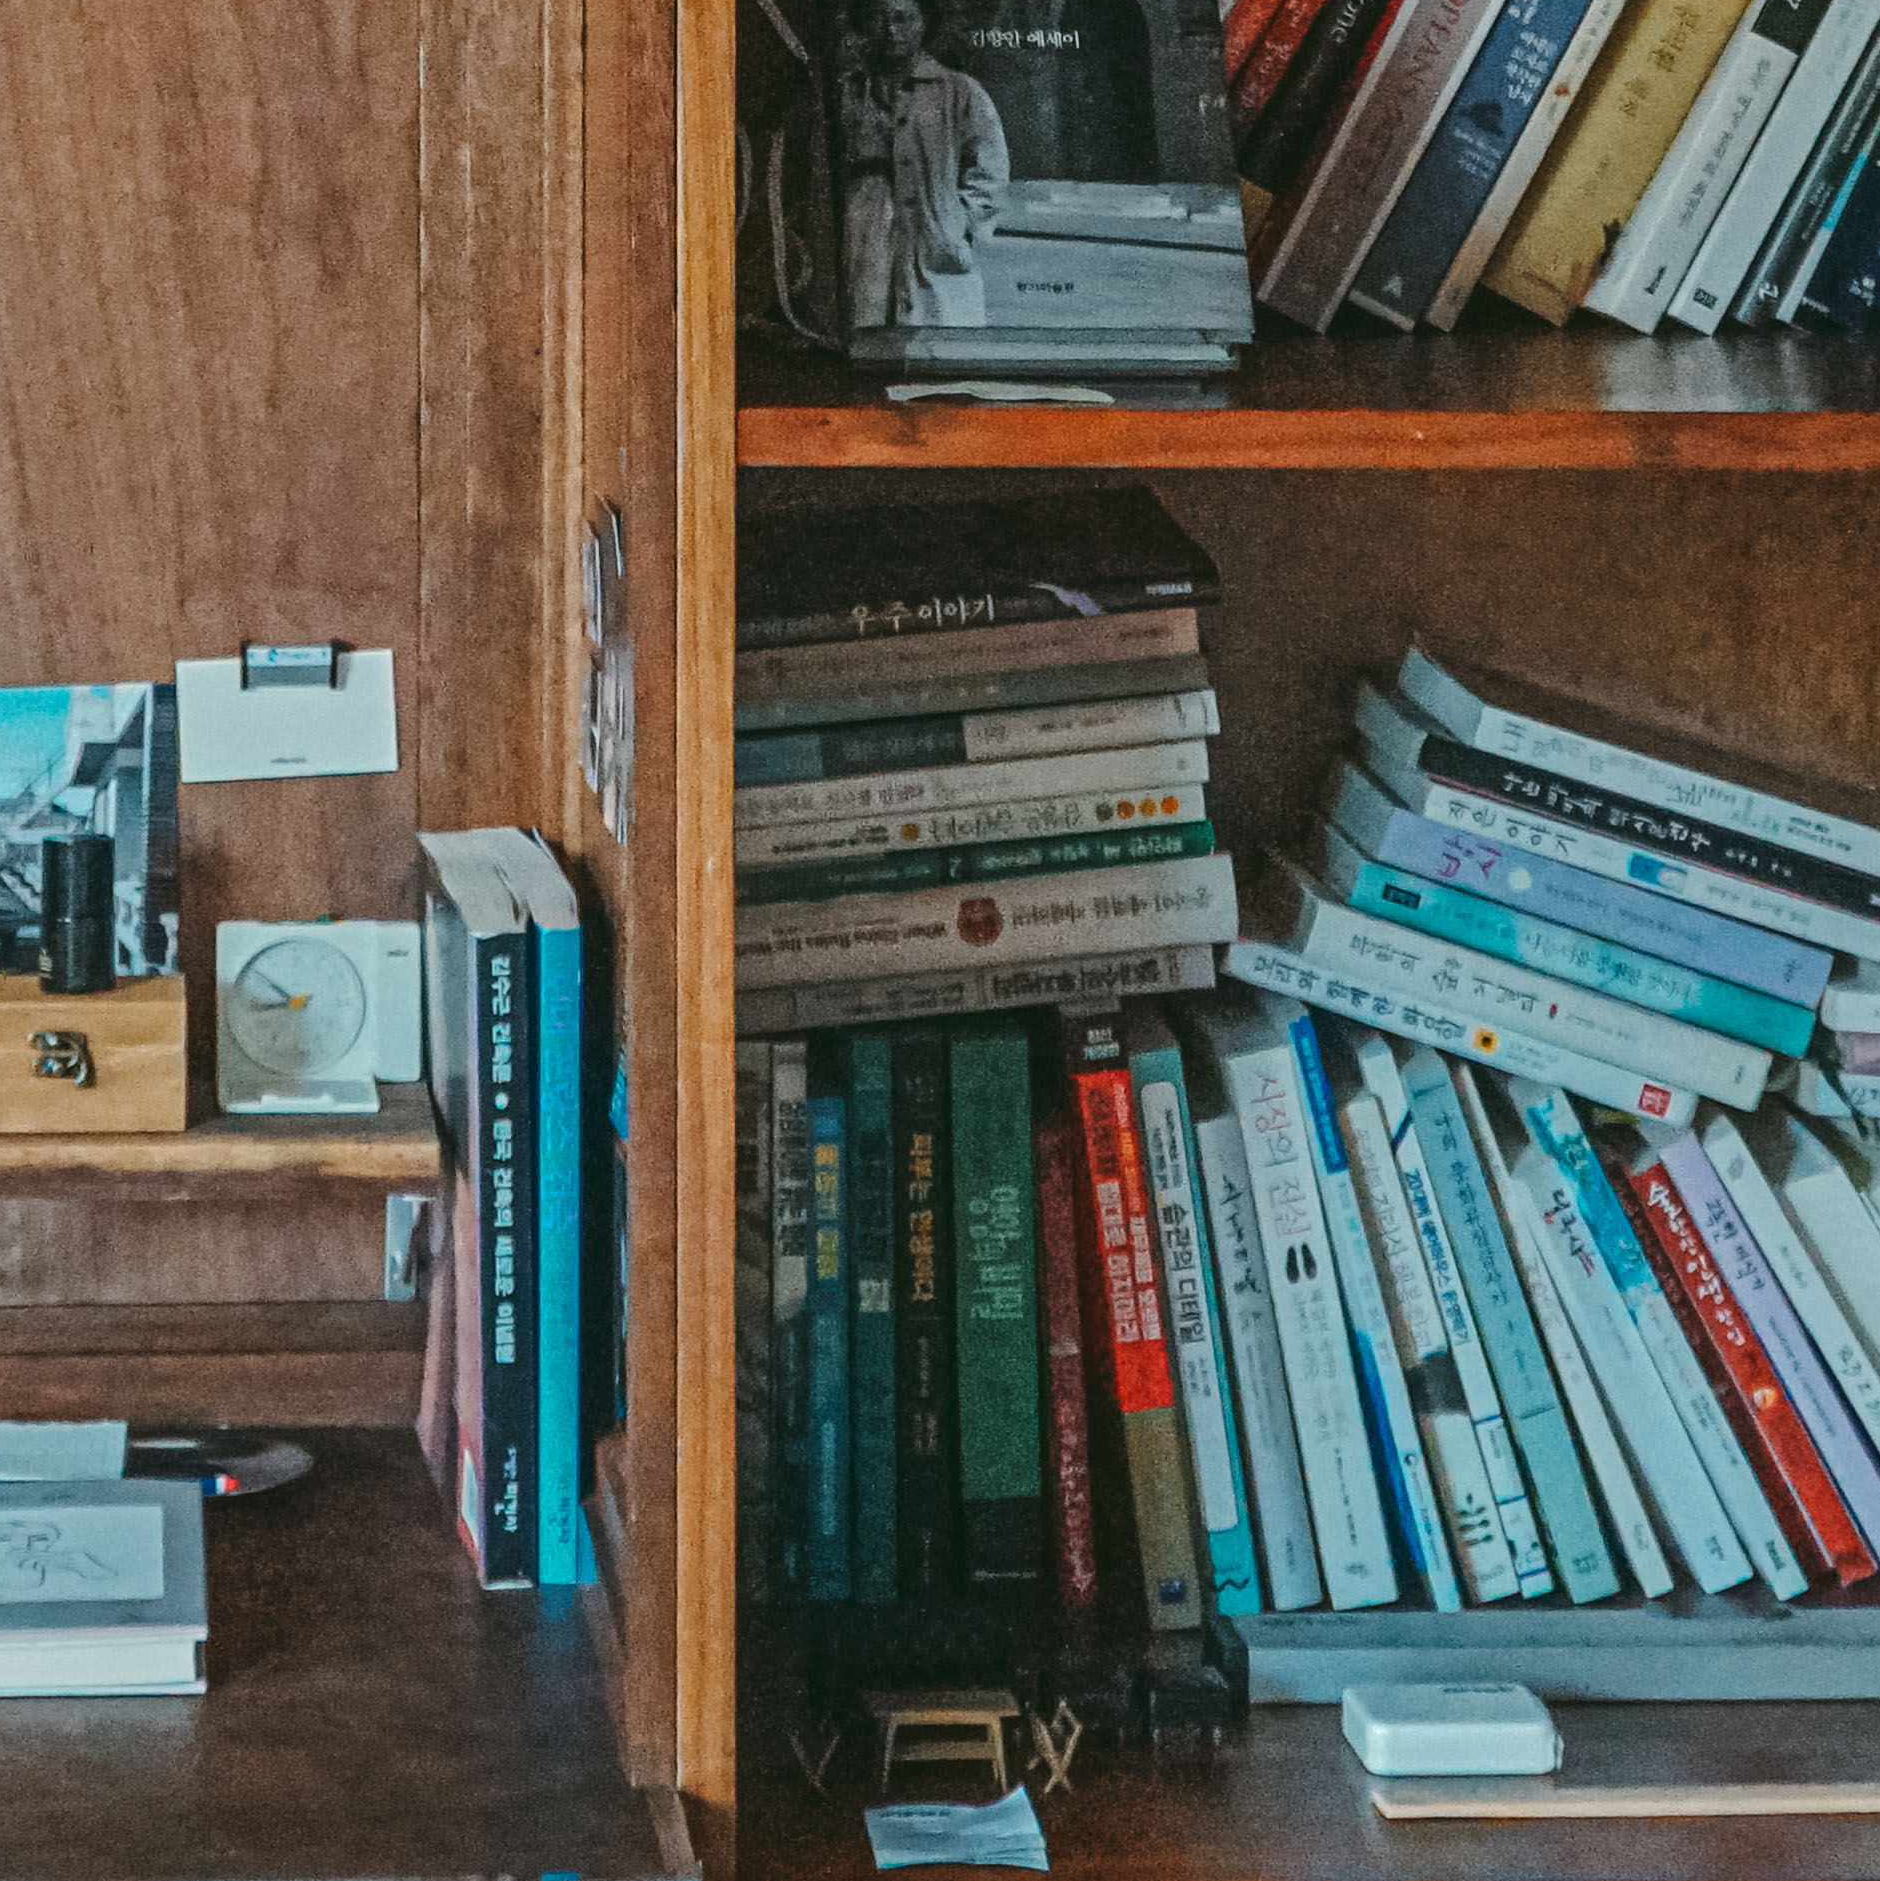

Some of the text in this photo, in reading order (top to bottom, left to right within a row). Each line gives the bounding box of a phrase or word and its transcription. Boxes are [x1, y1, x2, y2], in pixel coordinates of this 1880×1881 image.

[1026, 30, 1080, 48] 에세이
[850, 592, 996, 635] 우주 이야기
[1502, 816, 1578, 856] 이야기
[490, 955, 511, 1014] 김수근
[1248, 1073, 1298, 1169] 시장의
[492, 1168, 512, 1227] 건축의
[1368, 1190, 1410, 1260] 지리산
[492, 1235, 513, 1295] 새로운
[967, 1263, 1024, 1321] 비밀
[1161, 1202, 1202, 1345] 습관의 디테일
